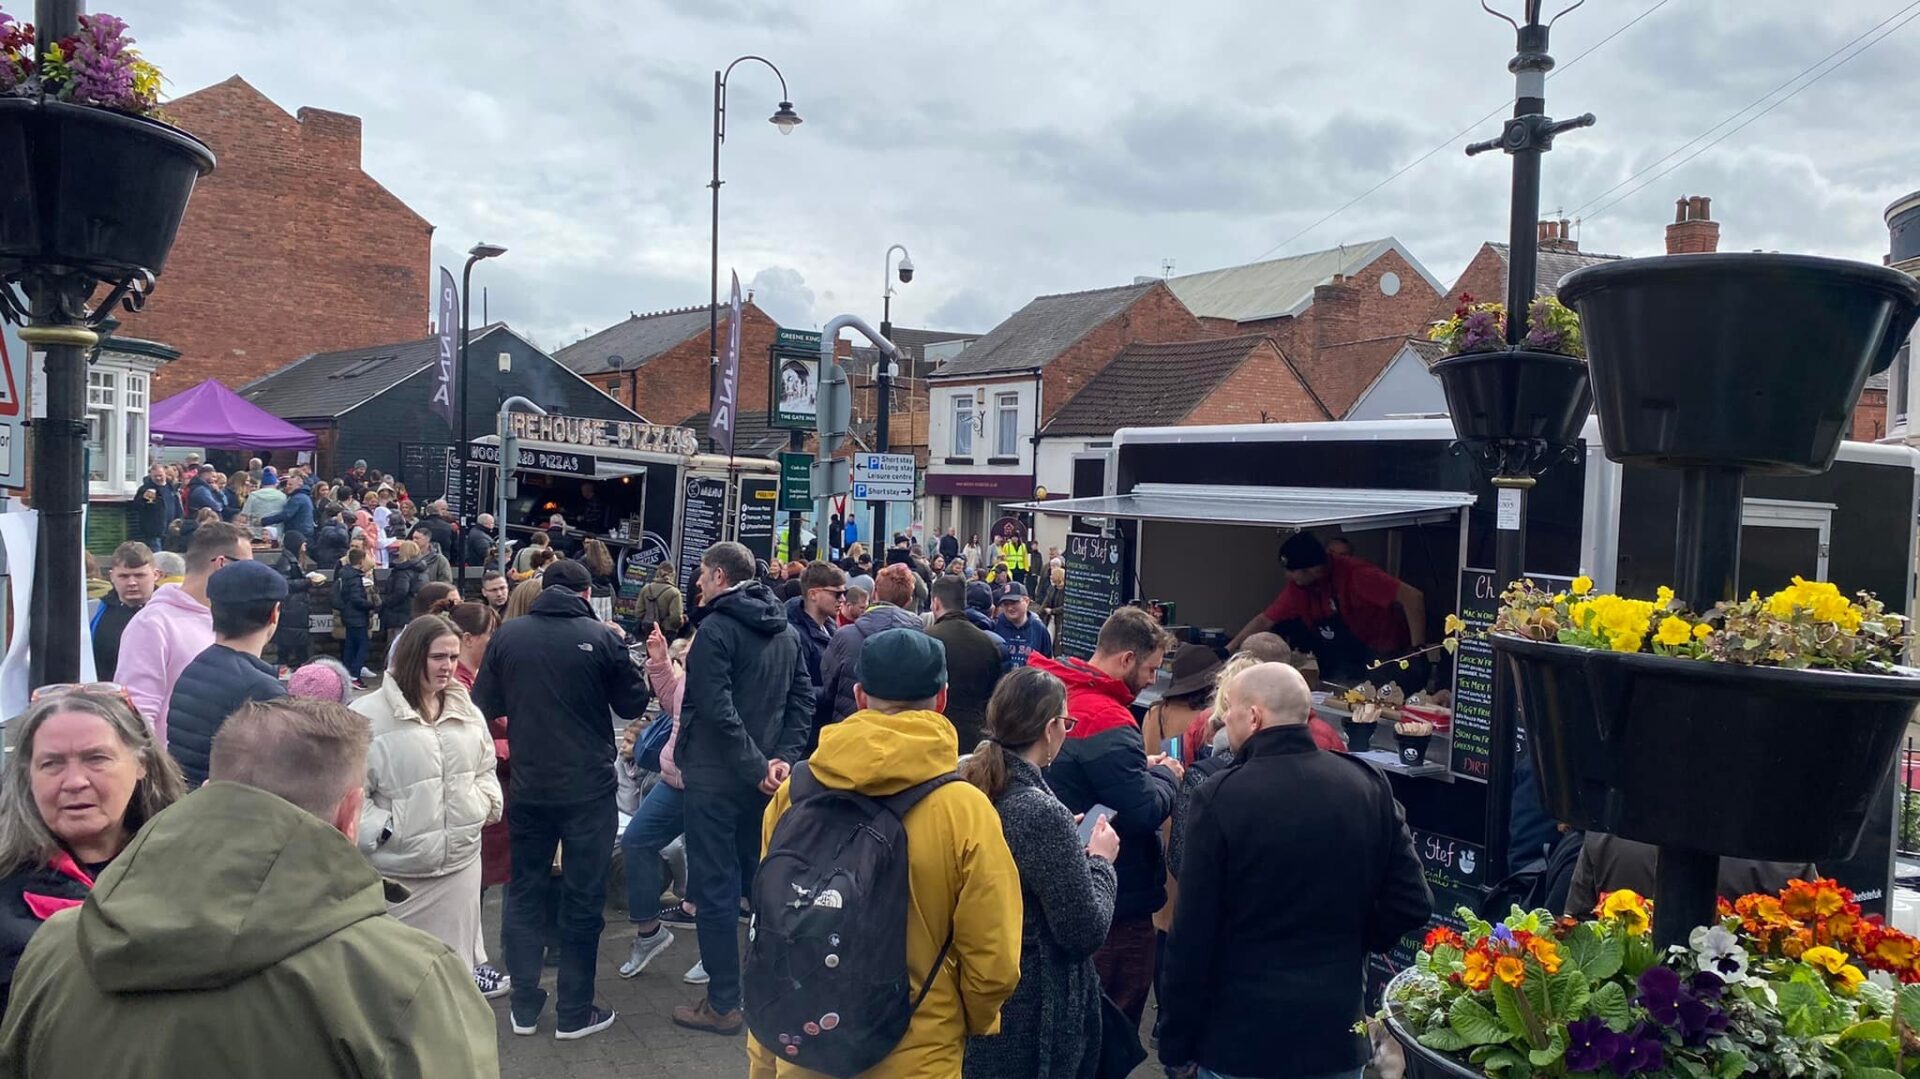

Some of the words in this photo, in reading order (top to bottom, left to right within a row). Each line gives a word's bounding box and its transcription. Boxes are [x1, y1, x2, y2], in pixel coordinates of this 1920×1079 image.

[805, 334, 820, 342] KING
[617, 422, 698, 455] PIZZAS
[539, 454, 579, 471] PIZZAS
[881, 456, 898, 464] Short
[900, 458, 913, 466] stay
[1072, 537, 1088, 561] Chef
[1090, 538, 1108, 564] Stef
[1475, 575, 1495, 599] Ch
[1477, 706, 1491, 718] FRIE
[1464, 757, 1488, 775] DIRT
[1424, 836, 1454, 868] Stef
